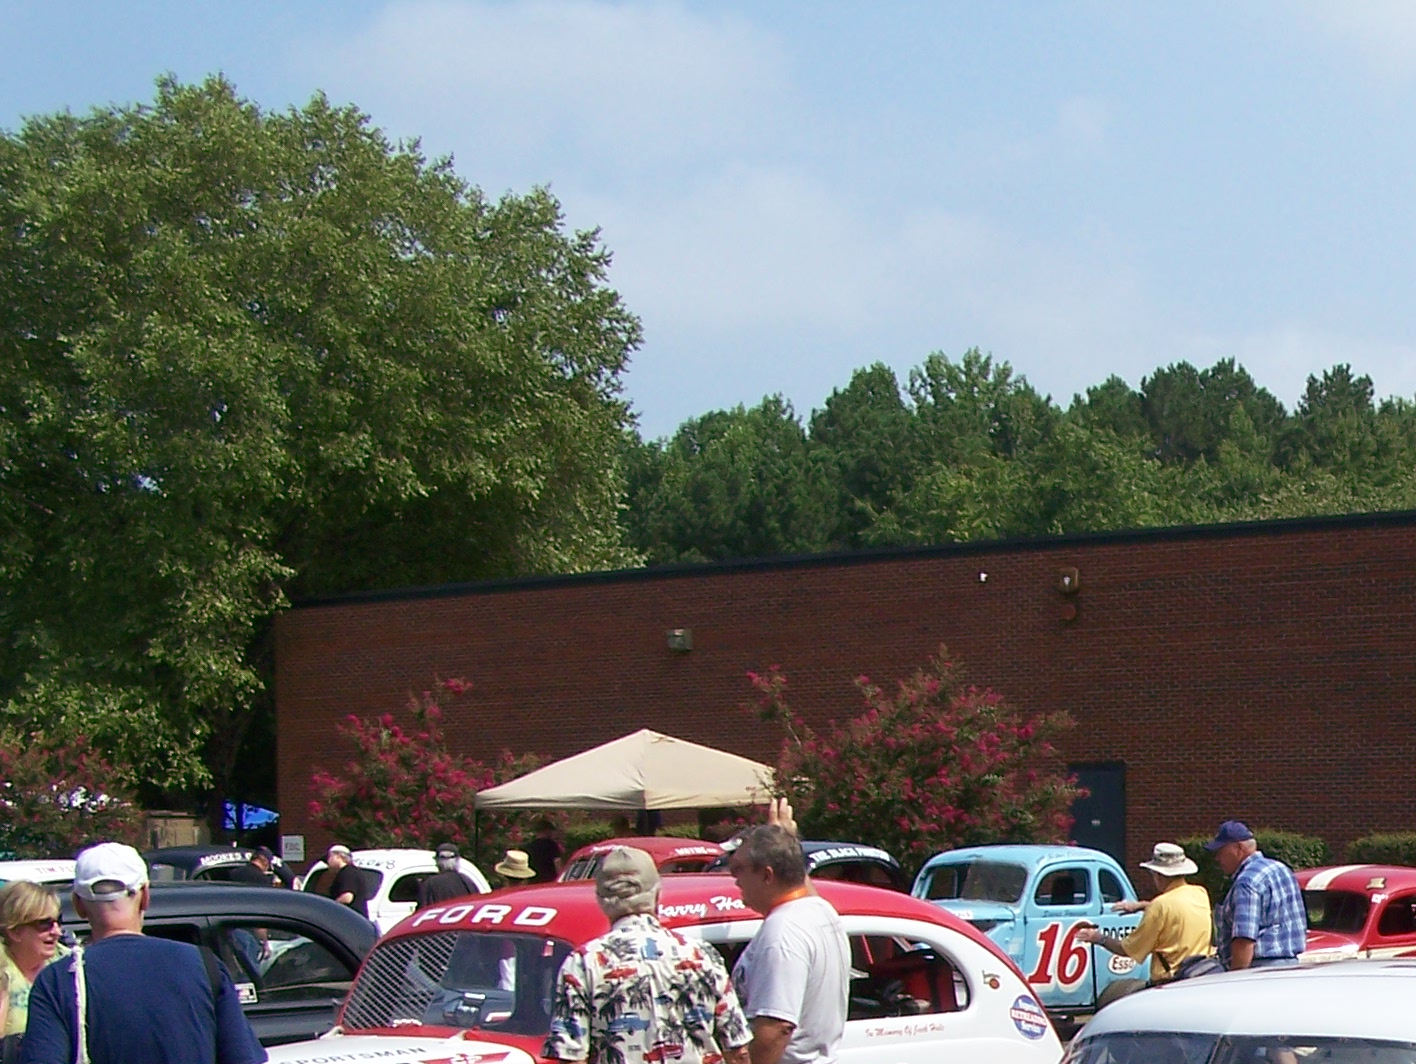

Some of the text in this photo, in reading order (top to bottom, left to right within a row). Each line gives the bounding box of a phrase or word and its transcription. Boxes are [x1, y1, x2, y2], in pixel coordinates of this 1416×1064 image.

[413, 904, 558, 927] FORD
[658, 903, 707, 918] arry
[1028, 920, 1092, 986] 16
